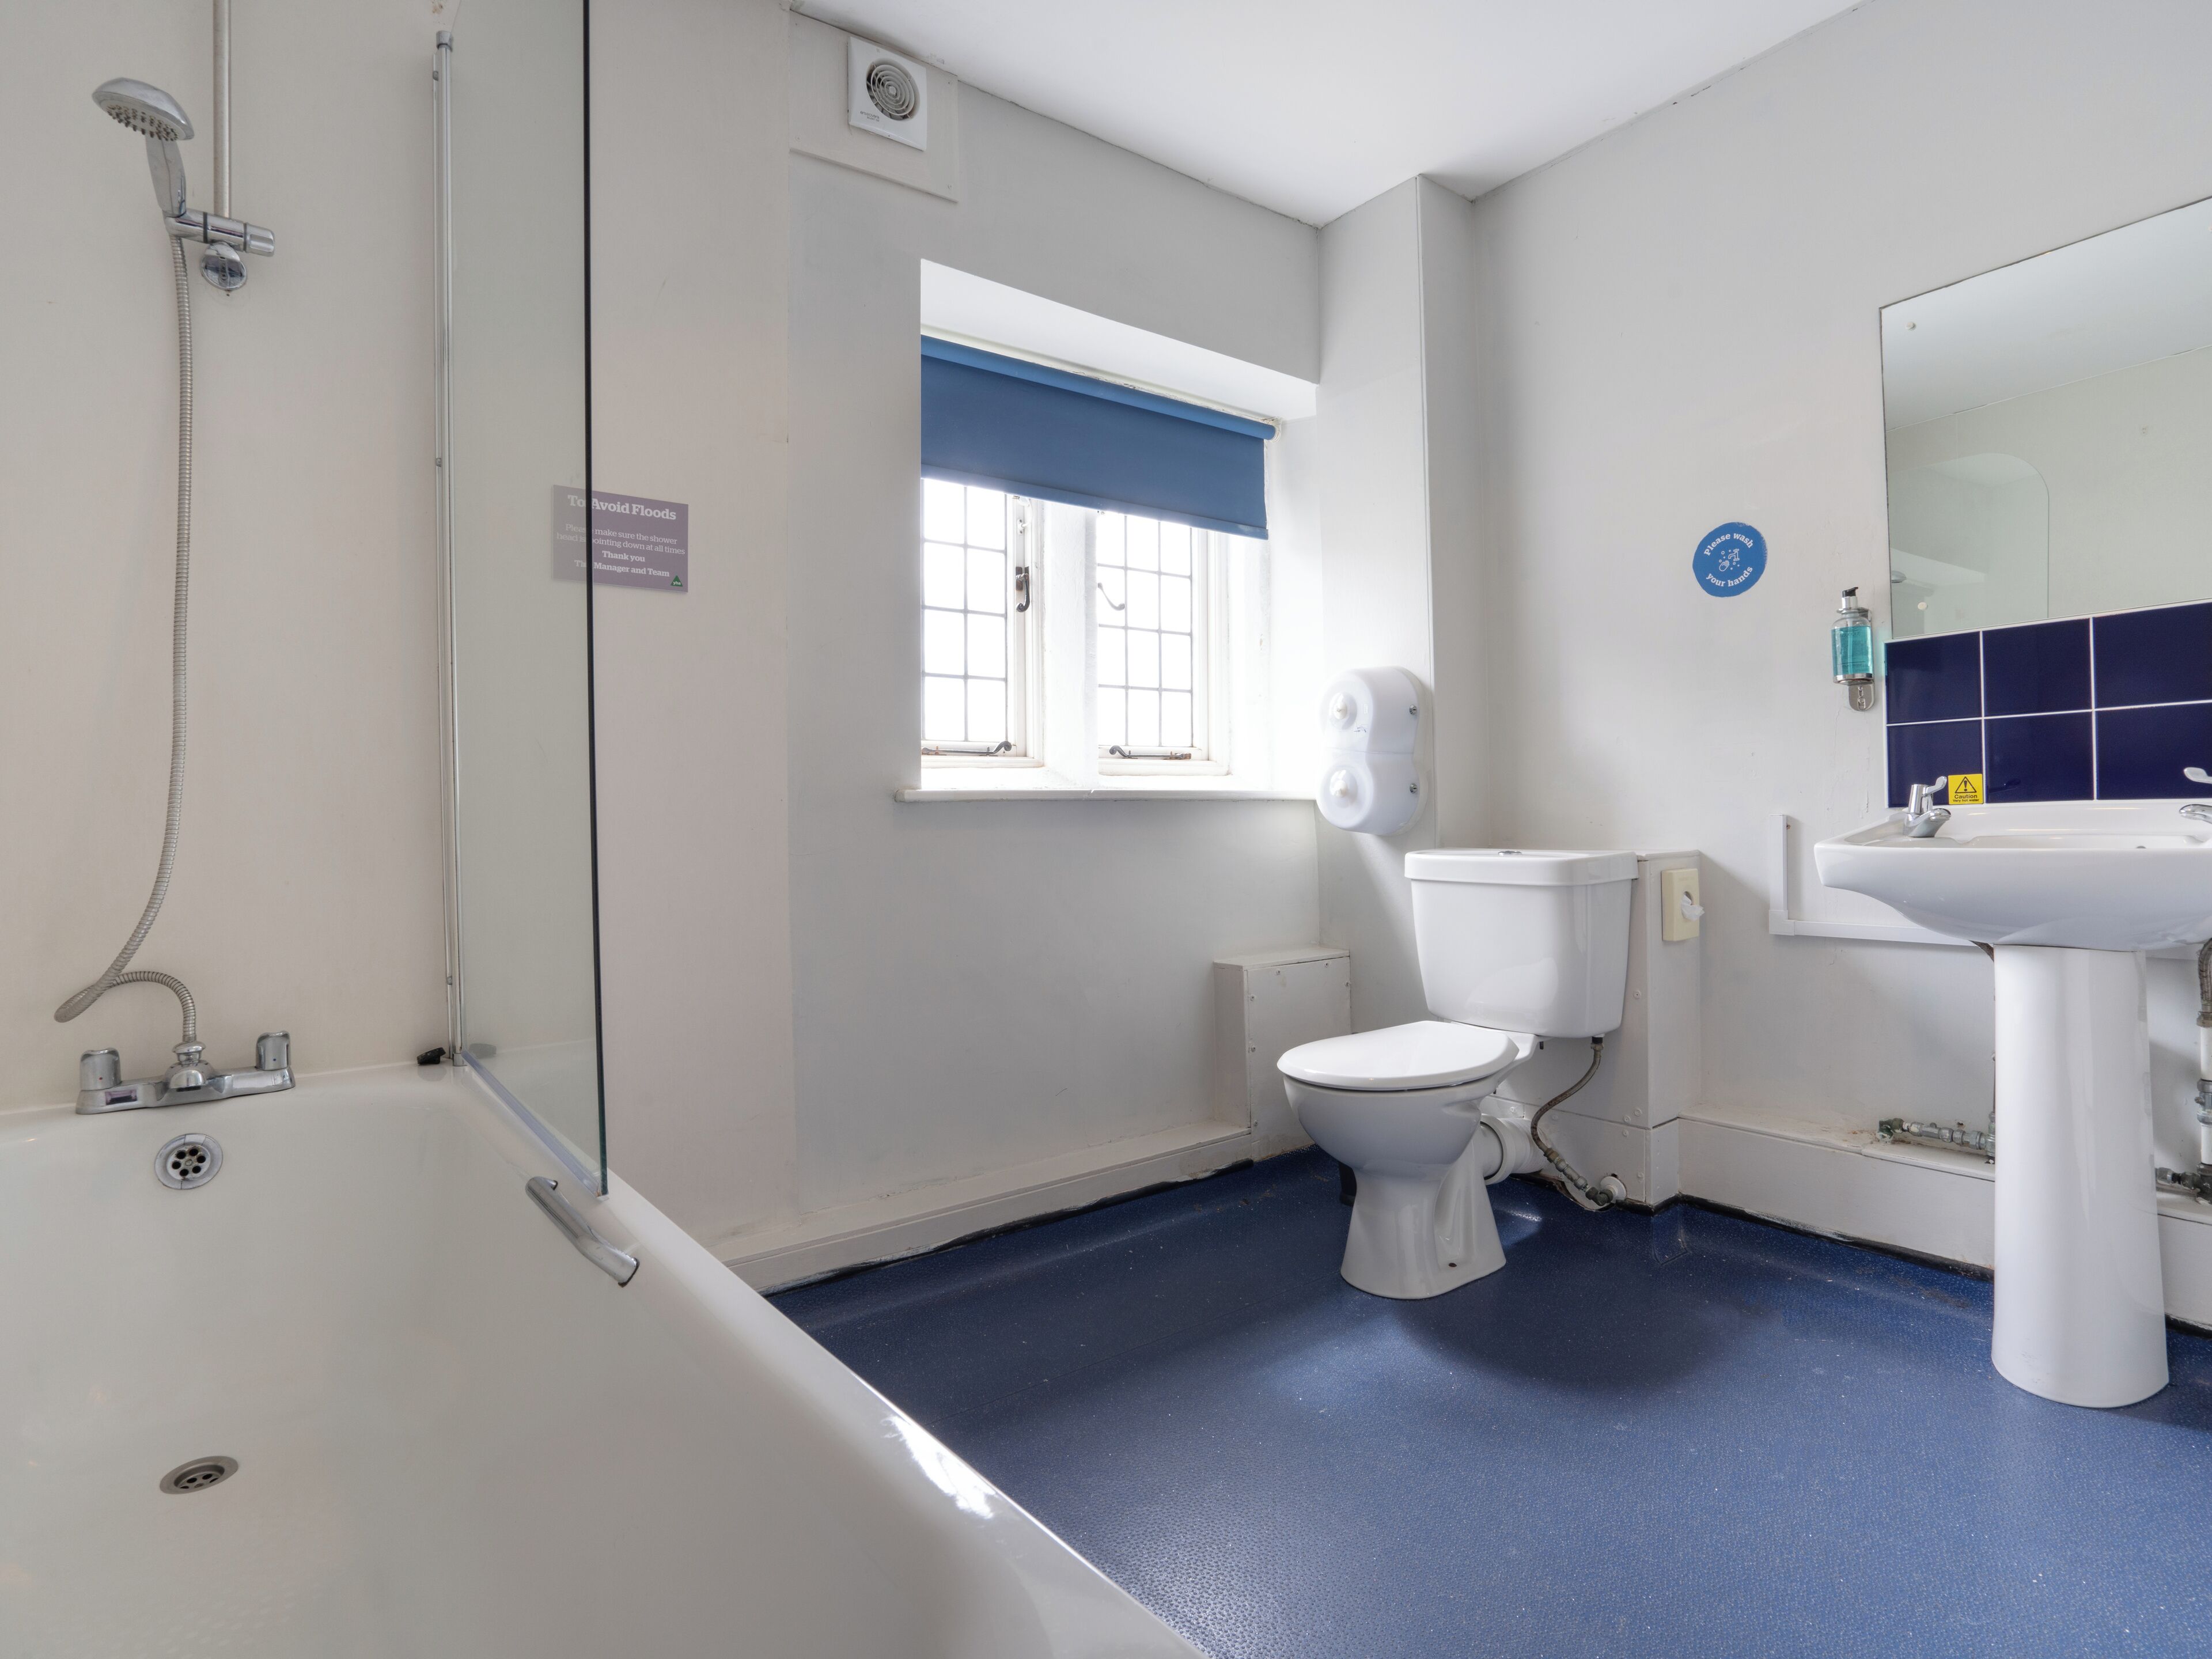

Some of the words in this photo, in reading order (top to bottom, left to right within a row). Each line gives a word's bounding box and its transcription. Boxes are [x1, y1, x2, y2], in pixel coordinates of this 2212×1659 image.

[567, 495, 586, 507] To
[592, 498, 630, 514] Avoid
[631, 504, 676, 520] Floods
[556, 532, 578, 541] head
[592, 538, 621, 548] ointing
[623, 541, 645, 550] down
[665, 546, 685, 555] times
[566, 524, 593, 534] Pleas
[595, 529, 617, 537] make
[650, 535, 677, 544] shower
[1704, 533, 1731, 556] Please
[1733, 533, 1753, 548] wash
[602, 550, 628, 560] Thank
[594, 562, 629, 573] Manager
[631, 567, 646, 575] and
[647, 568, 669, 577] Team
[1706, 573, 1725, 587] your
[1728, 567, 1753, 586] hands
